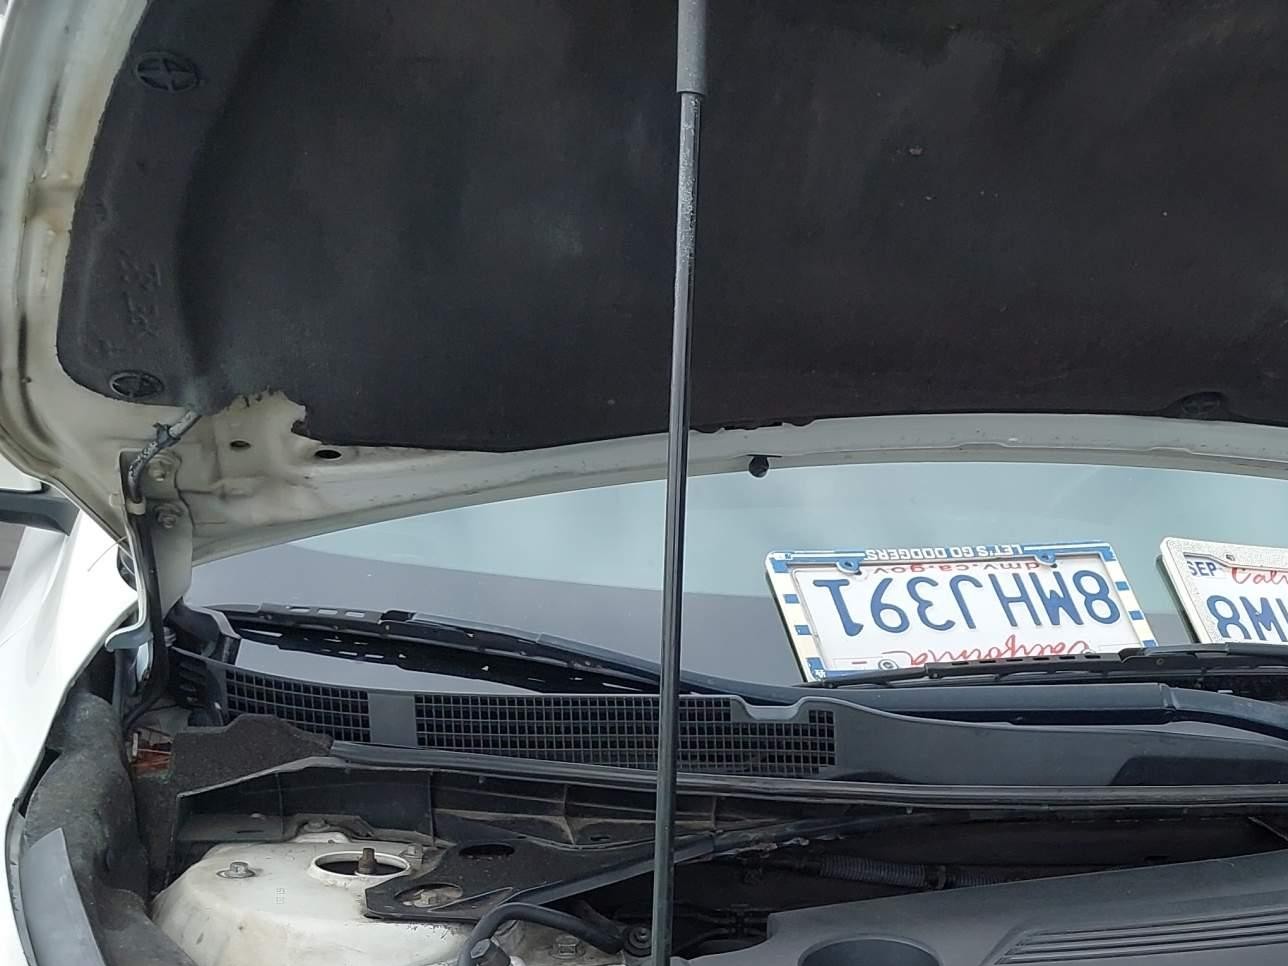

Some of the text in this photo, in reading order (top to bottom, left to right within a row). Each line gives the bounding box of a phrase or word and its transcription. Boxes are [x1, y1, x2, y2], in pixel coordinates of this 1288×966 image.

[864, 544, 1023, 560] LET'S GO DODGERS
[873, 561, 1040, 575] dmv.ca.gov
[1187, 560, 1217, 578] SEP
[813, 570, 1121, 637] 8MHJ391
